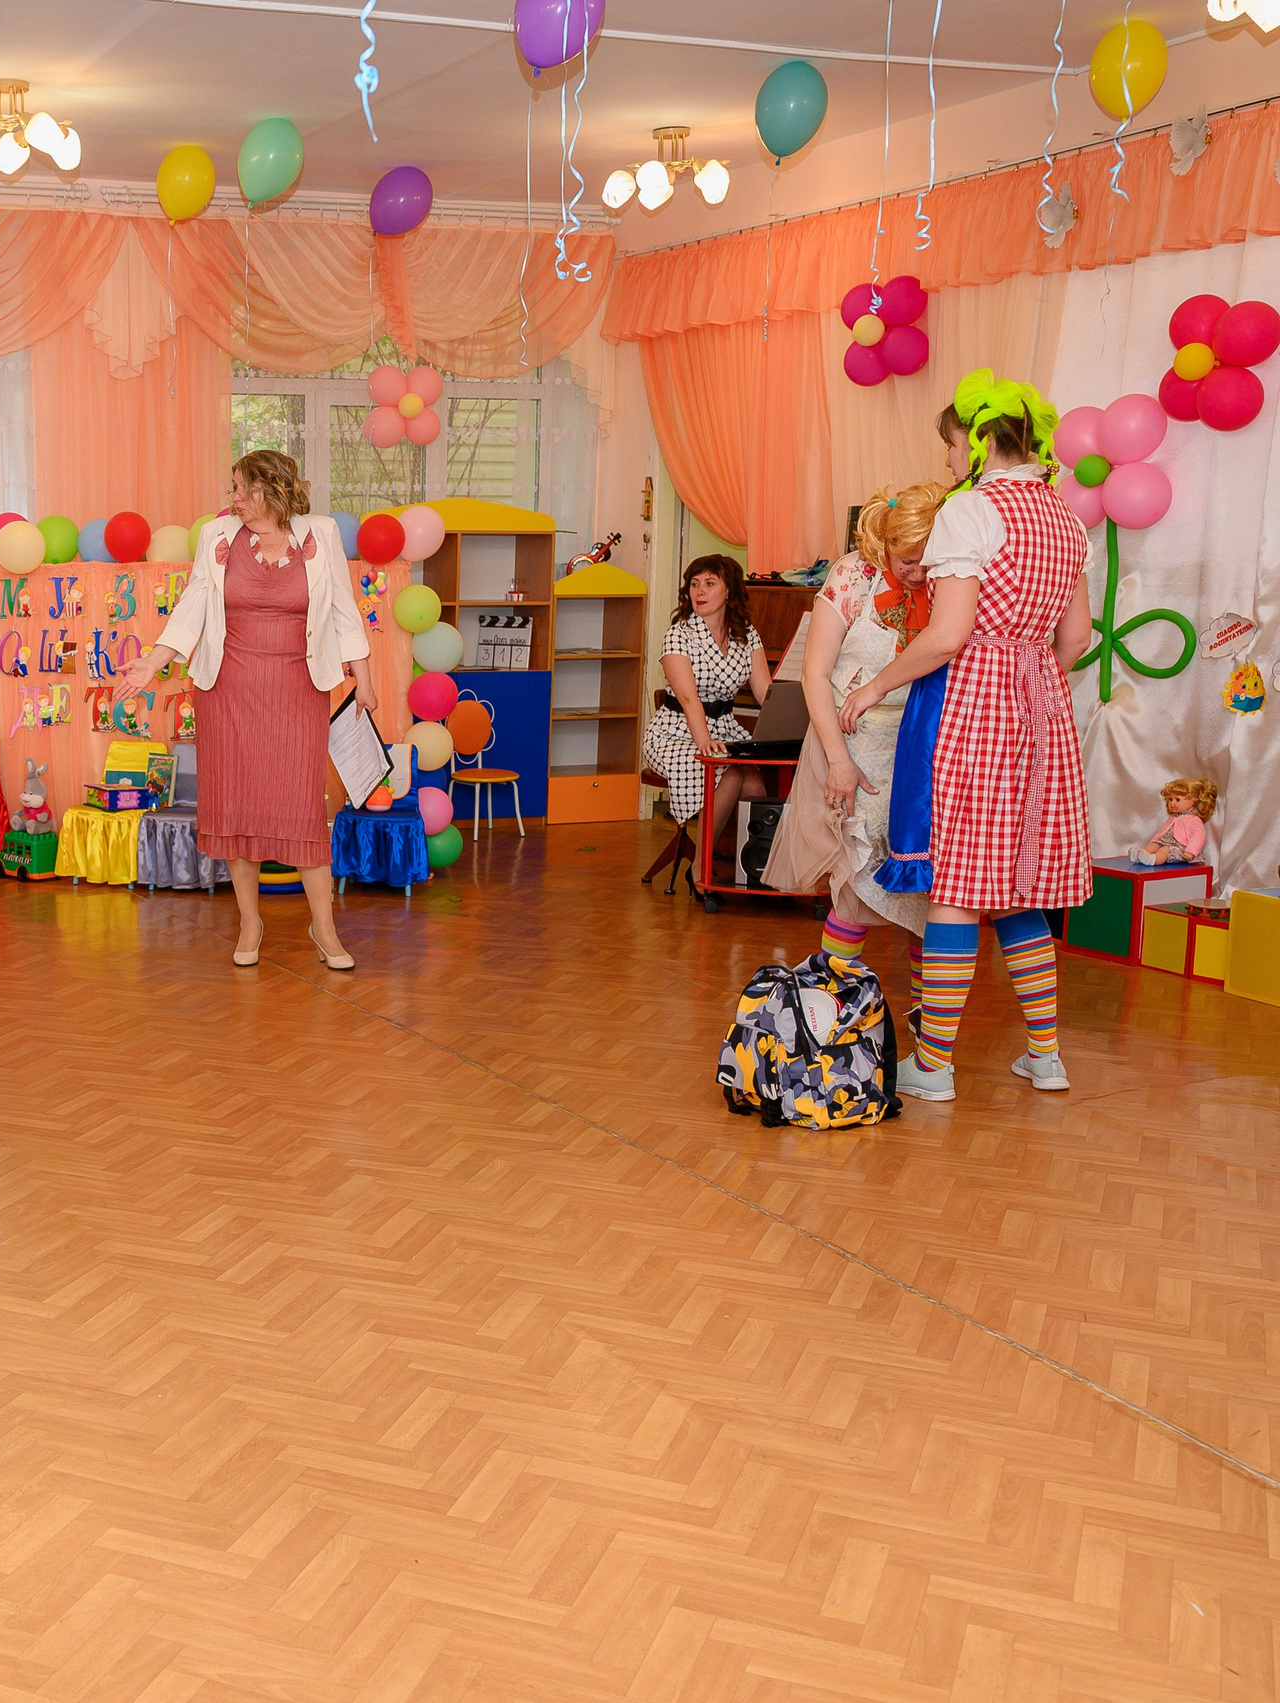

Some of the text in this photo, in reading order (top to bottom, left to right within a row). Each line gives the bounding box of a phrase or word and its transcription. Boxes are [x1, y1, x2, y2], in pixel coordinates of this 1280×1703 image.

[1216, 621, 1242, 639] СПАСИБО
[482, 648, 523, 662] 3 1 2
